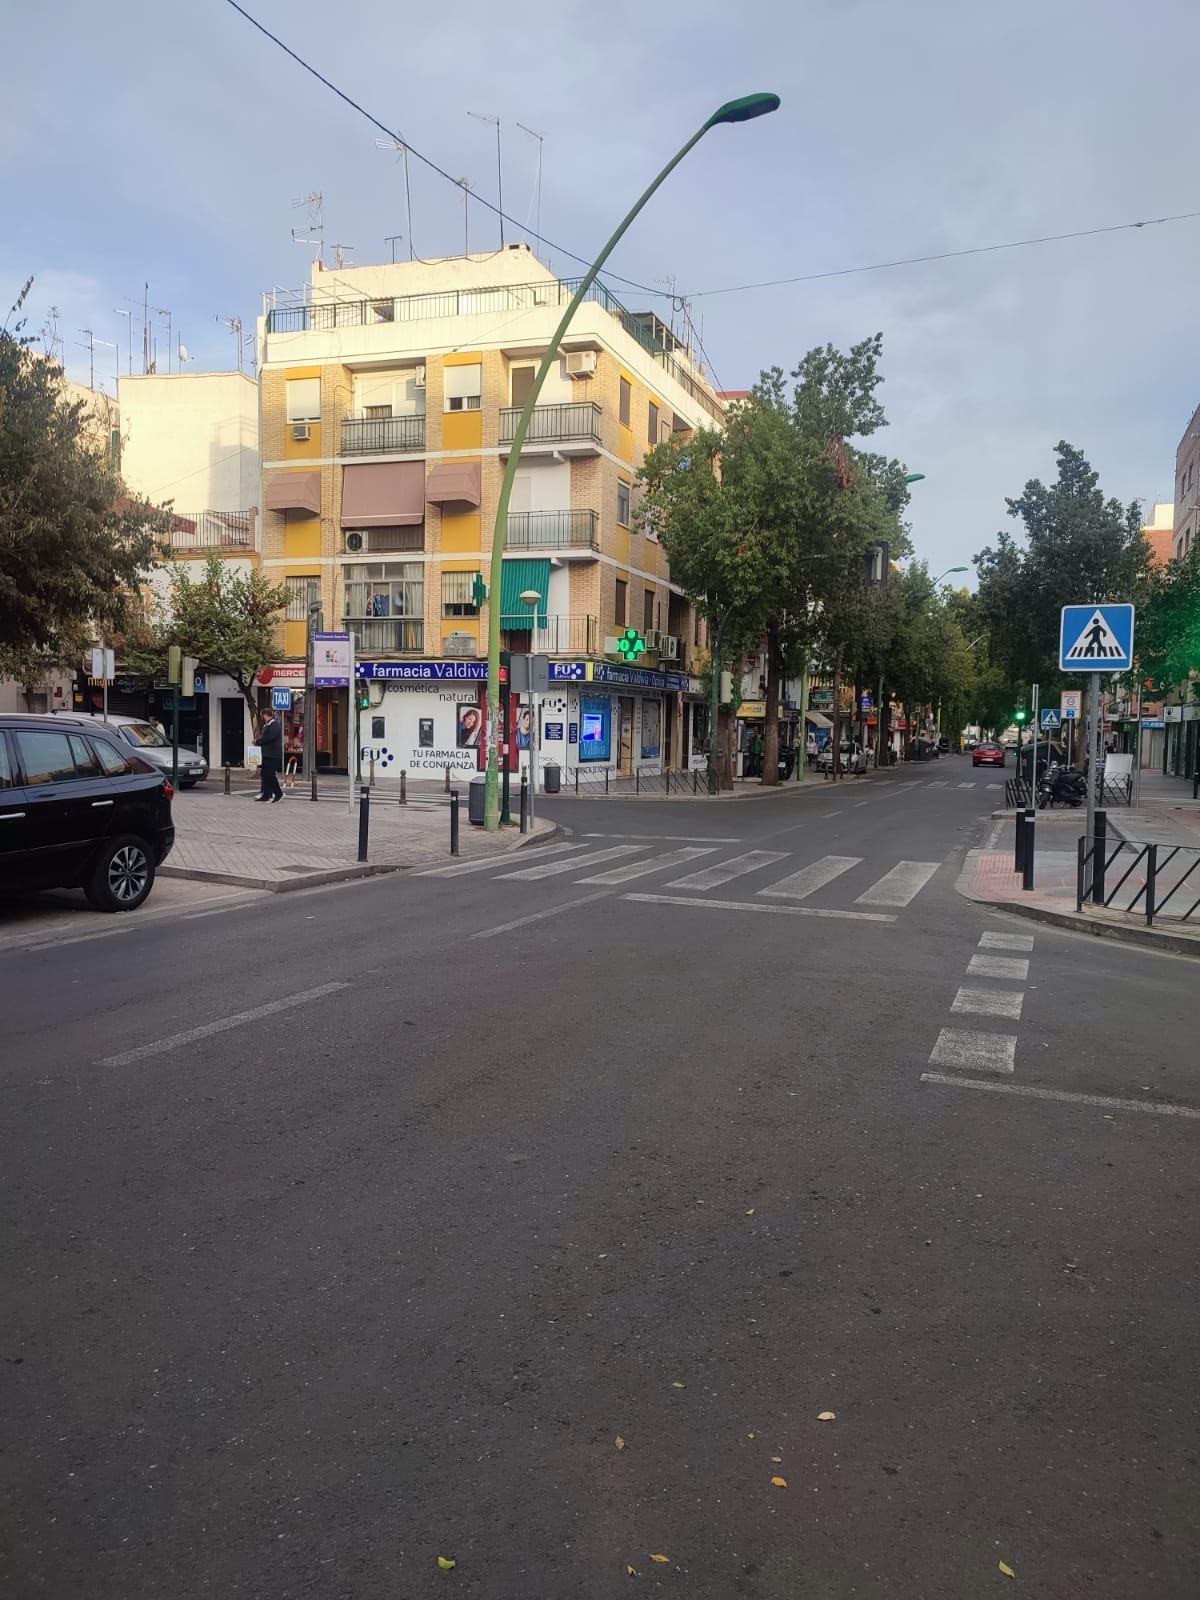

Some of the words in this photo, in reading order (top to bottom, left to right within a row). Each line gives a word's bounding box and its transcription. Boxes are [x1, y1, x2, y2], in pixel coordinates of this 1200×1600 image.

[373, 664, 431, 678] farmacia
[387, 682, 439, 694] cosmética
[274, 692, 289, 705] TAXI
[440, 689, 478, 702] natural
[412, 749, 424, 758] TU
[425, 750, 471, 759] FARMACIA
[409, 760, 421, 768] DE
[422, 760, 475, 770] CONFIANZA
